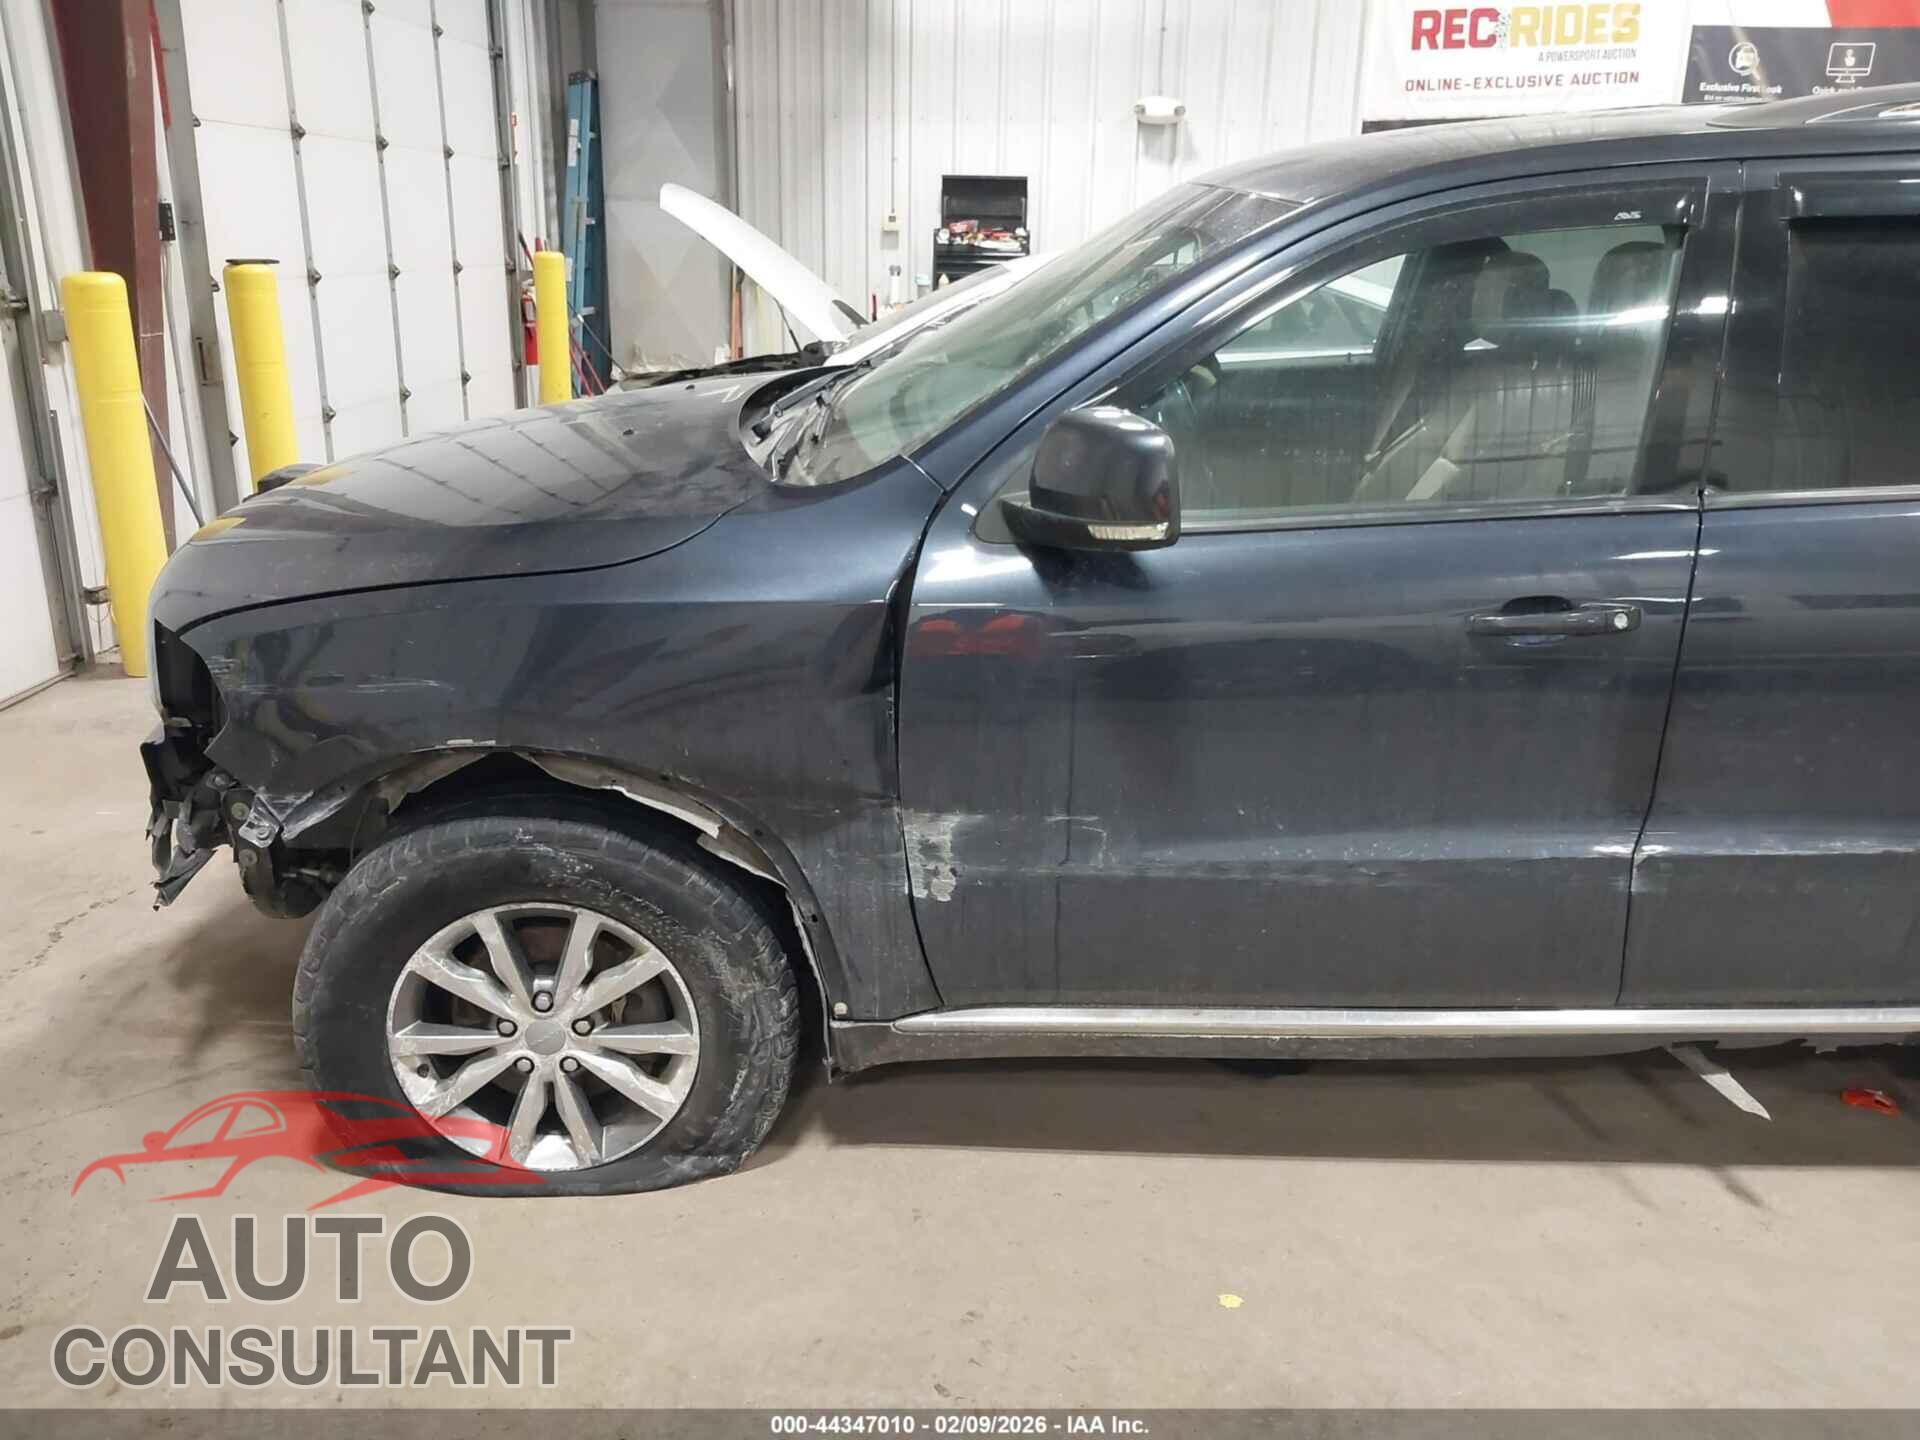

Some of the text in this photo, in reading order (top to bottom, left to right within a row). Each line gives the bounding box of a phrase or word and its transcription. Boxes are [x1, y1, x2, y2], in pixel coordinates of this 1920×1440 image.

[1411, 3, 1641, 50] REC RIDES
[1538, 48, 1637, 62] A POWERSPORT AUCTION
[1405, 71, 1640, 92] ONLINE-EXCLUSIVE AUCTION
[1699, 82, 1740, 92] Exclusive
